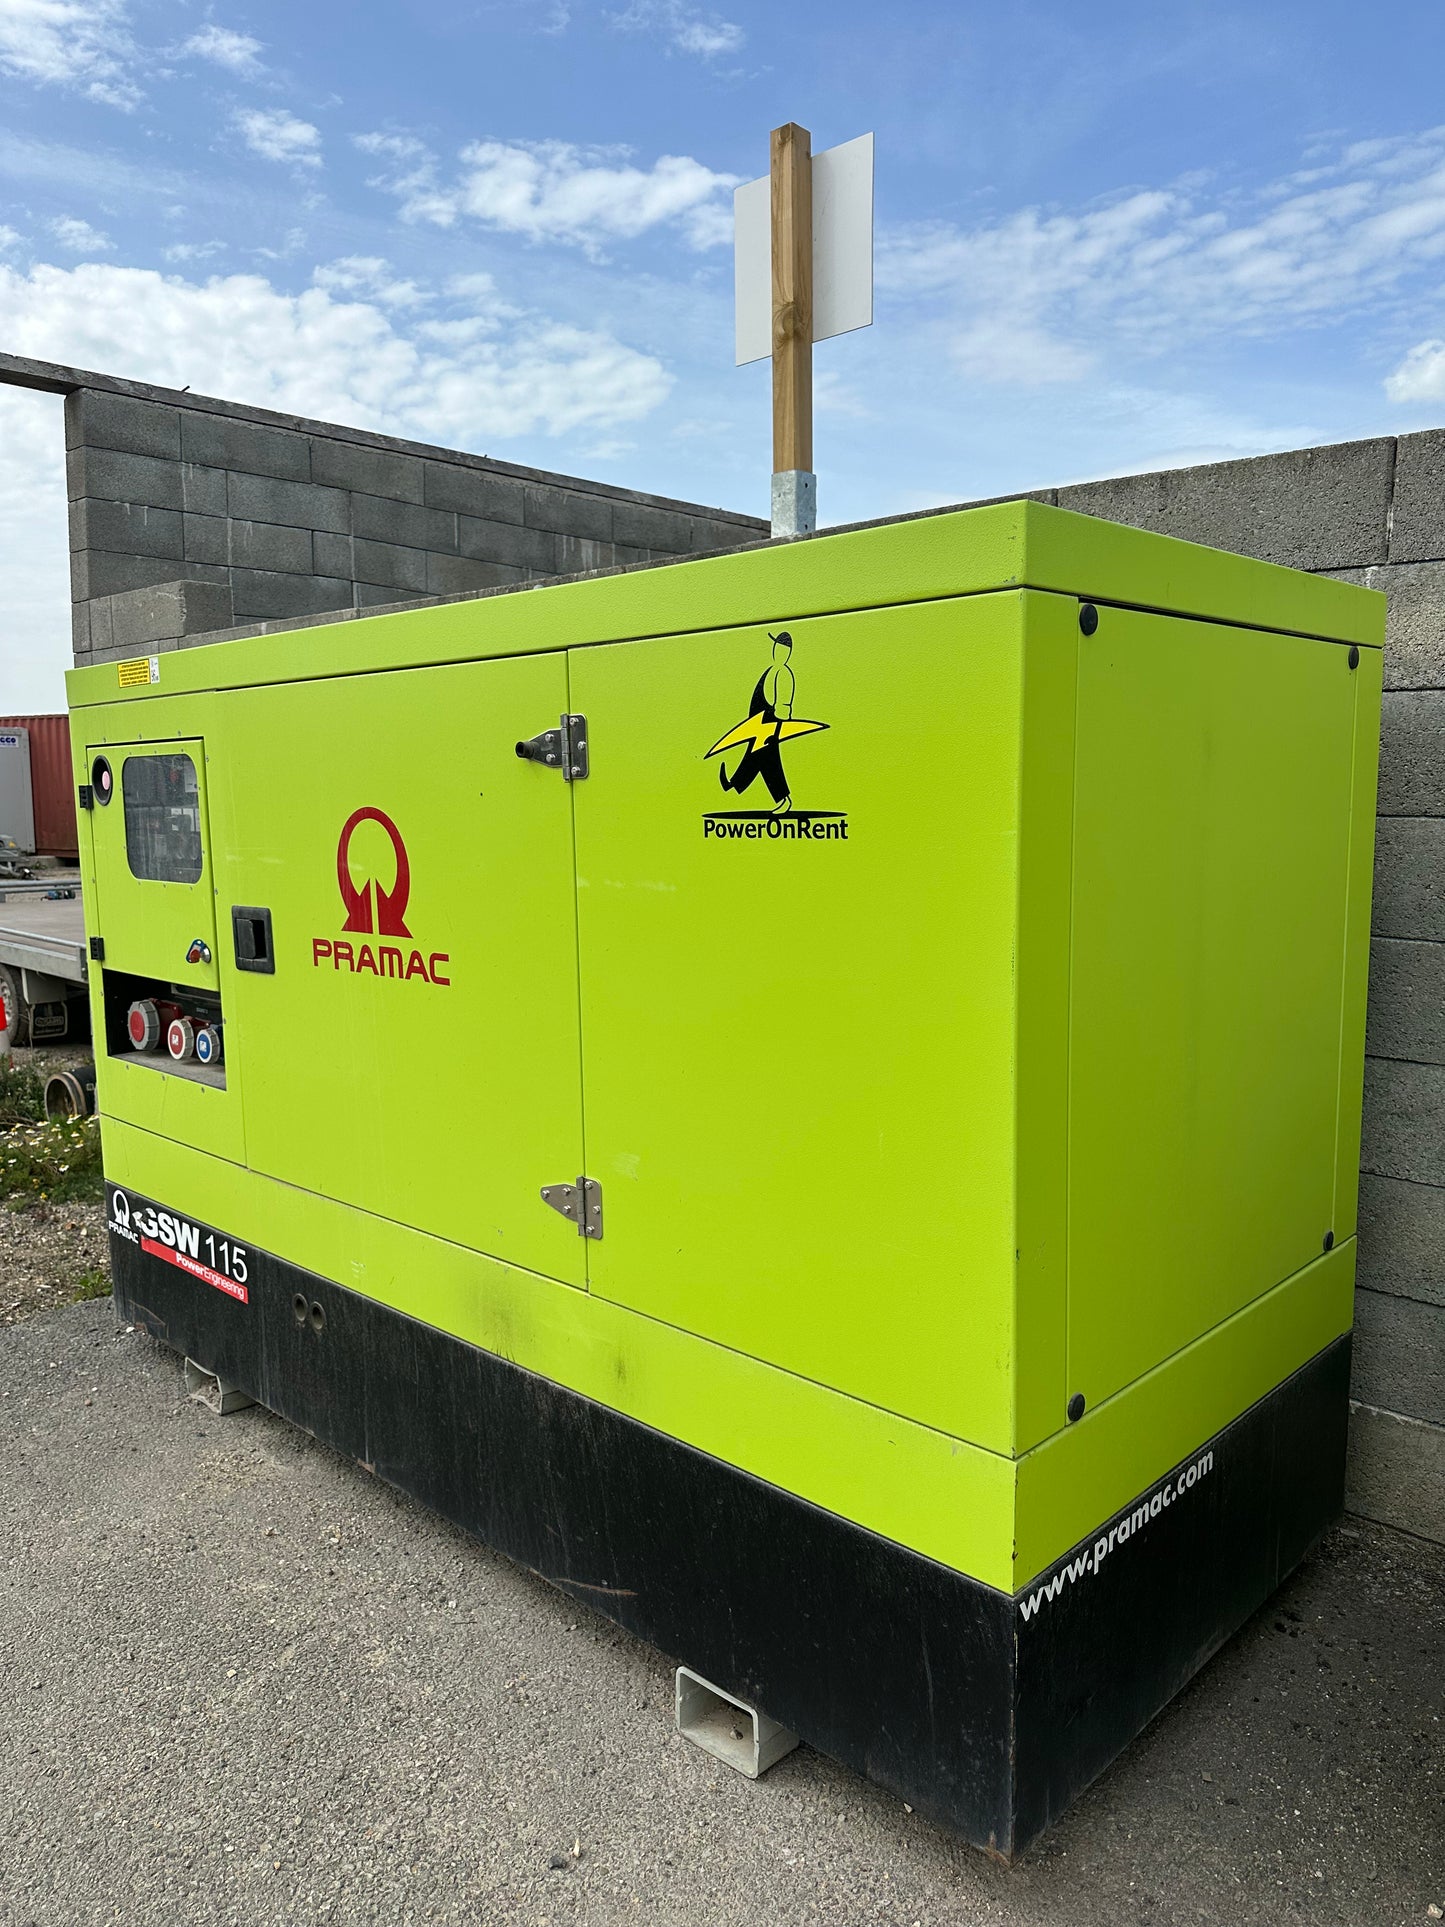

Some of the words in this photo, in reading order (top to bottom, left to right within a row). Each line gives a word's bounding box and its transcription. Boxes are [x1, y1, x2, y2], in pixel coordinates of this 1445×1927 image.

[703, 817, 849, 840] PowerOnRent
[312, 937, 451, 987] PRAMAC
[139, 1207, 201, 1259] GSW
[205, 1234, 248, 1283] 115
[1019, 1450, 1214, 1622] www.pramac.com
